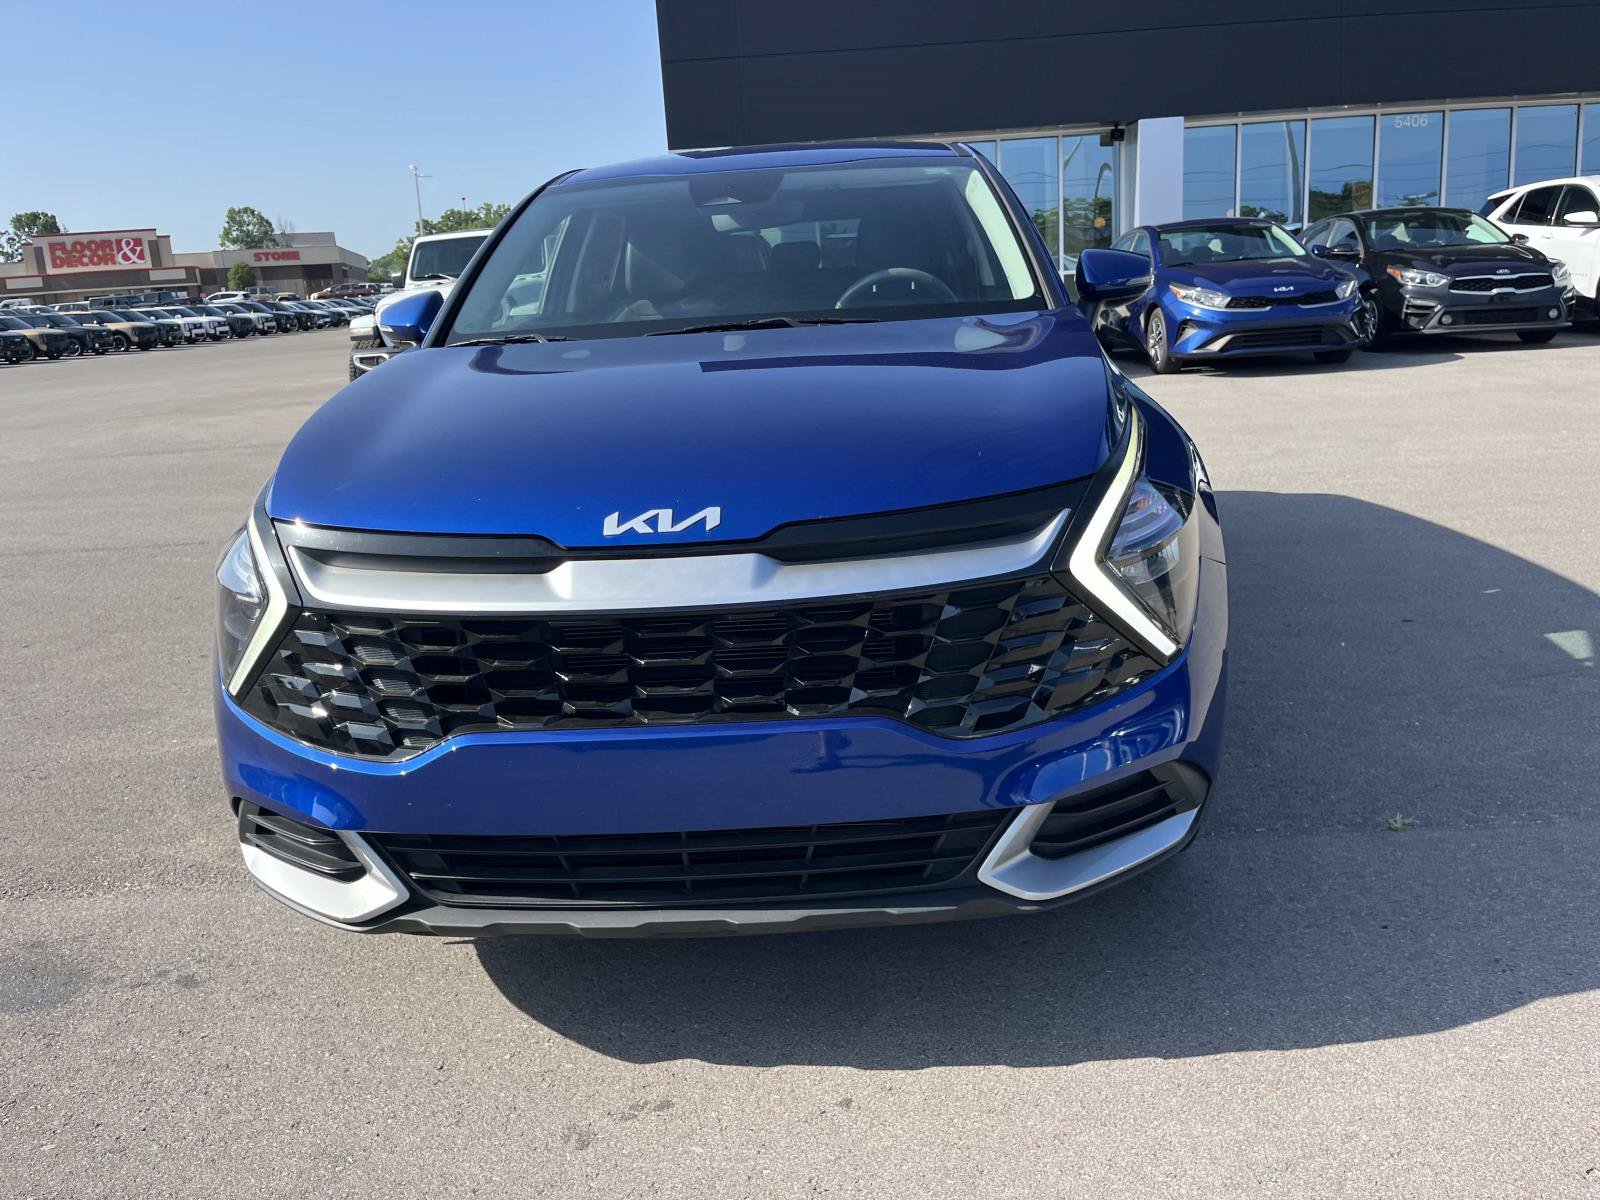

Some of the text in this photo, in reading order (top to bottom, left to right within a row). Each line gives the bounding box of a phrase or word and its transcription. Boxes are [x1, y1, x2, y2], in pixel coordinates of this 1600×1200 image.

[1394, 114, 1428, 128] 5406
[48, 240, 113, 258] FLOOR
[51, 252, 116, 268] DECOR
[603, 506, 721, 536] KIA
